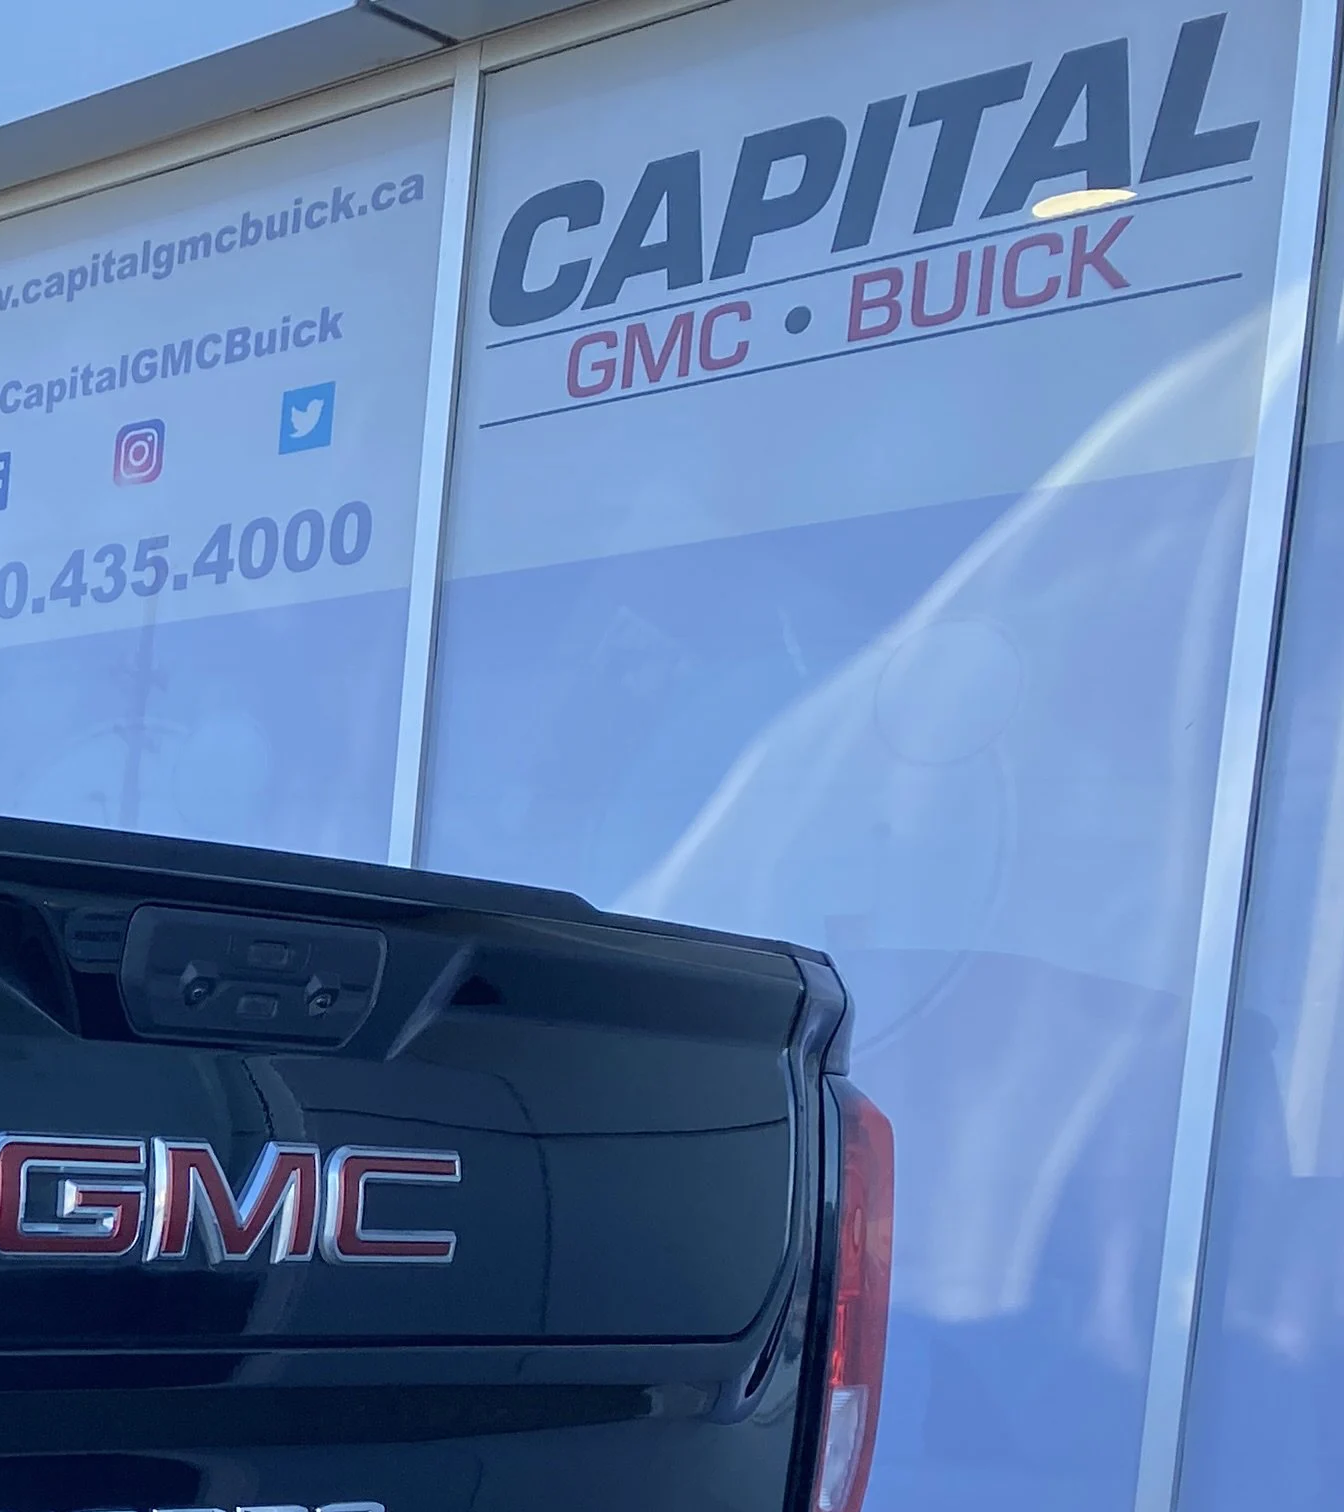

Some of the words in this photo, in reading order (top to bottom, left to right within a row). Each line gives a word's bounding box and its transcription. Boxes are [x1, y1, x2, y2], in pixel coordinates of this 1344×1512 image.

[488, 12, 1260, 328] CAPITAL
[565, 301, 752, 399] GMC
[846, 216, 1133, 343] BUICK
